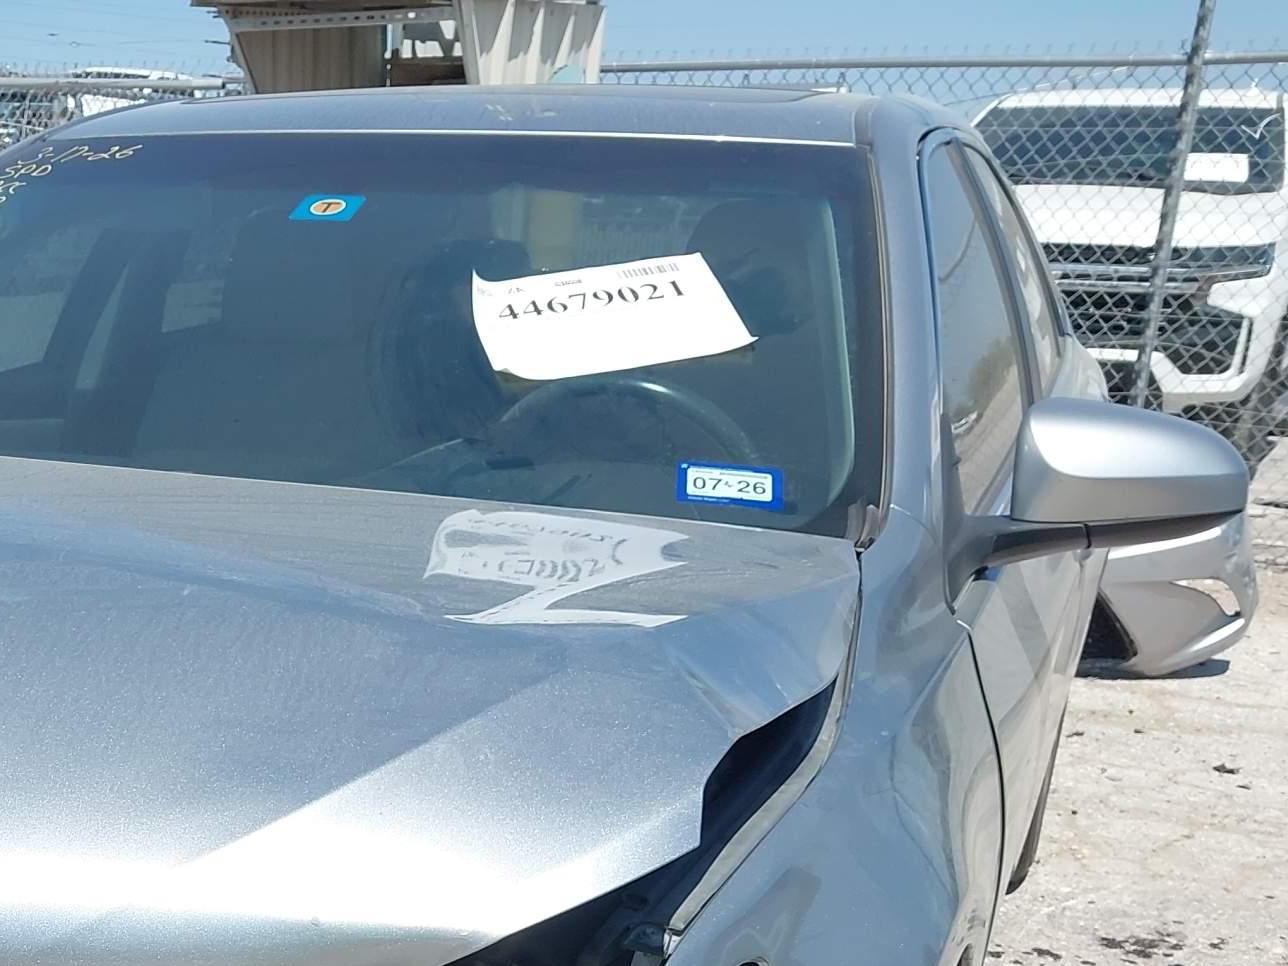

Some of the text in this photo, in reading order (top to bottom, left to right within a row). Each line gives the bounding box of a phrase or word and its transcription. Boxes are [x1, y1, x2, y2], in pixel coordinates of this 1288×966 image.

[17, 144, 143, 164] 3-17-26
[498, 279, 686, 320] 44679021
[692, 476, 767, 495] 07 26
